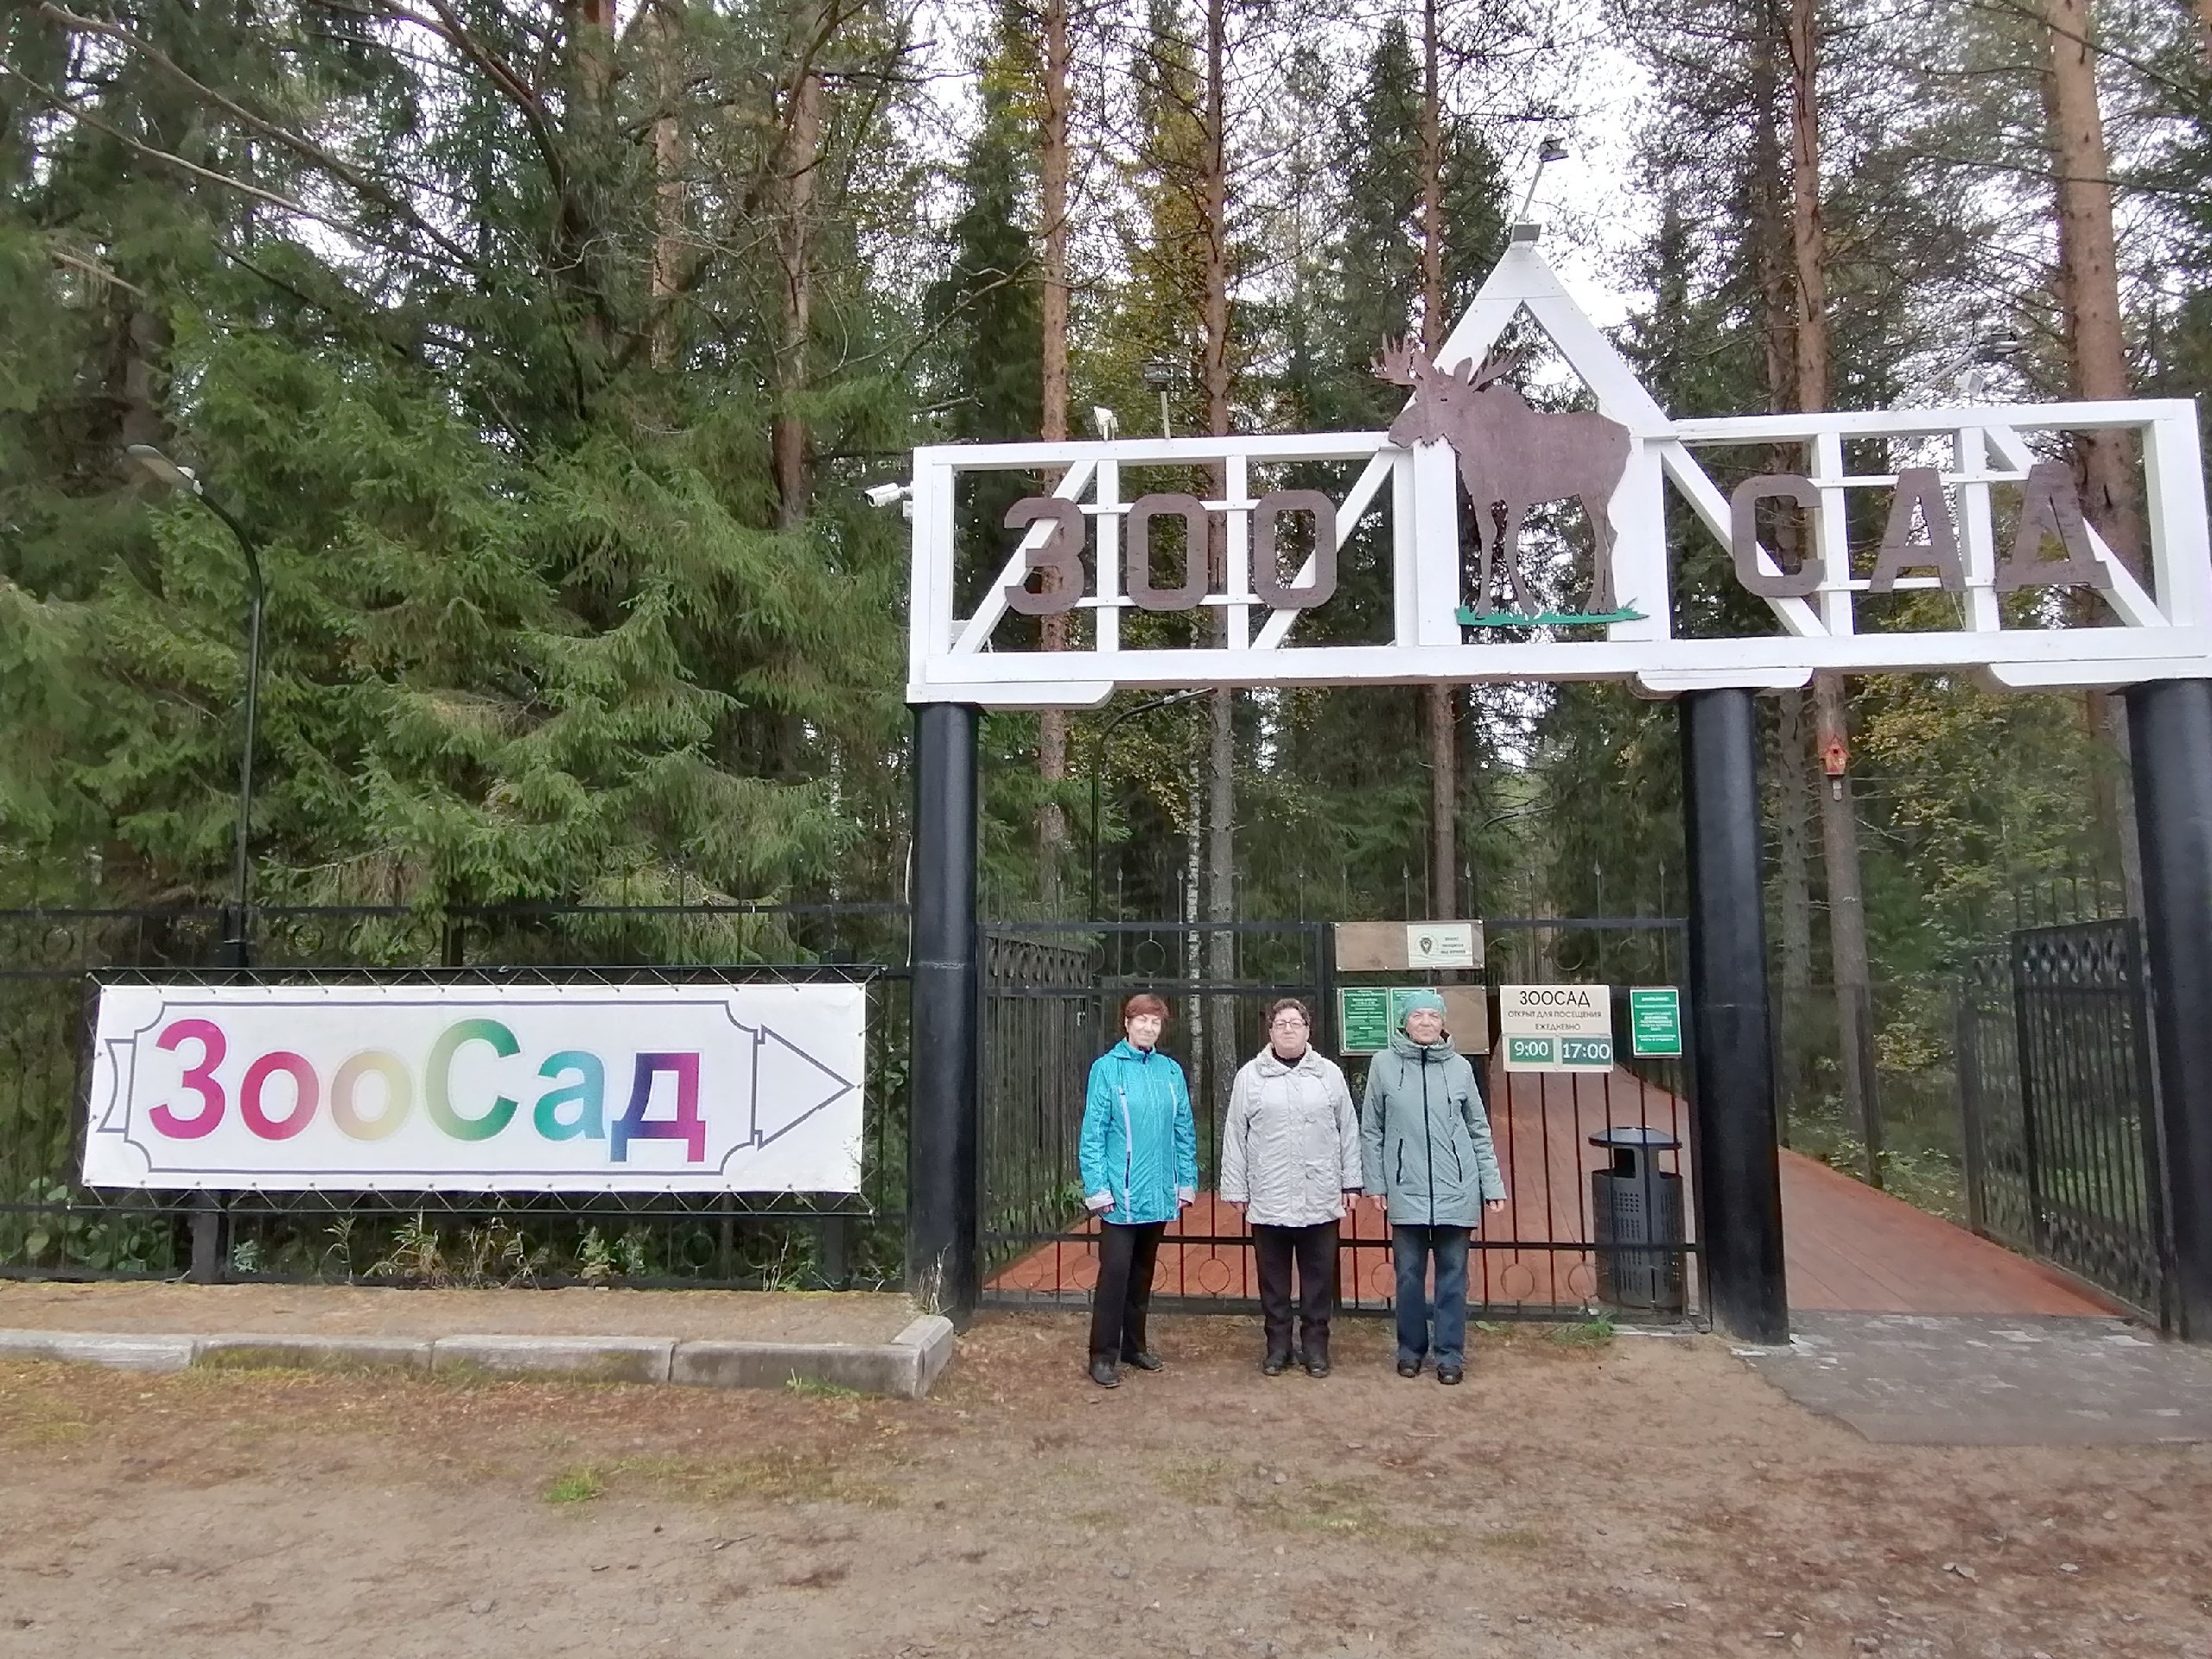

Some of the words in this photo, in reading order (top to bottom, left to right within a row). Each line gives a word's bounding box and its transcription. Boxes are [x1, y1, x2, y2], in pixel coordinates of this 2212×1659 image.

[1004, 489, 1338, 615] ЗОО
[1730, 463, 2113, 598] САД
[1519, 990, 1591, 1007] ЗООСАД
[1536, 1010, 1553, 1019] ДЛЯ
[1554, 1010, 1602, 1019] ПОСЕЩЕНИЯ
[1514, 1040, 1548, 1057] 9:00
[1562, 1043, 1611, 1059] 17:00
[148, 1018, 706, 1163] ЗооСад
